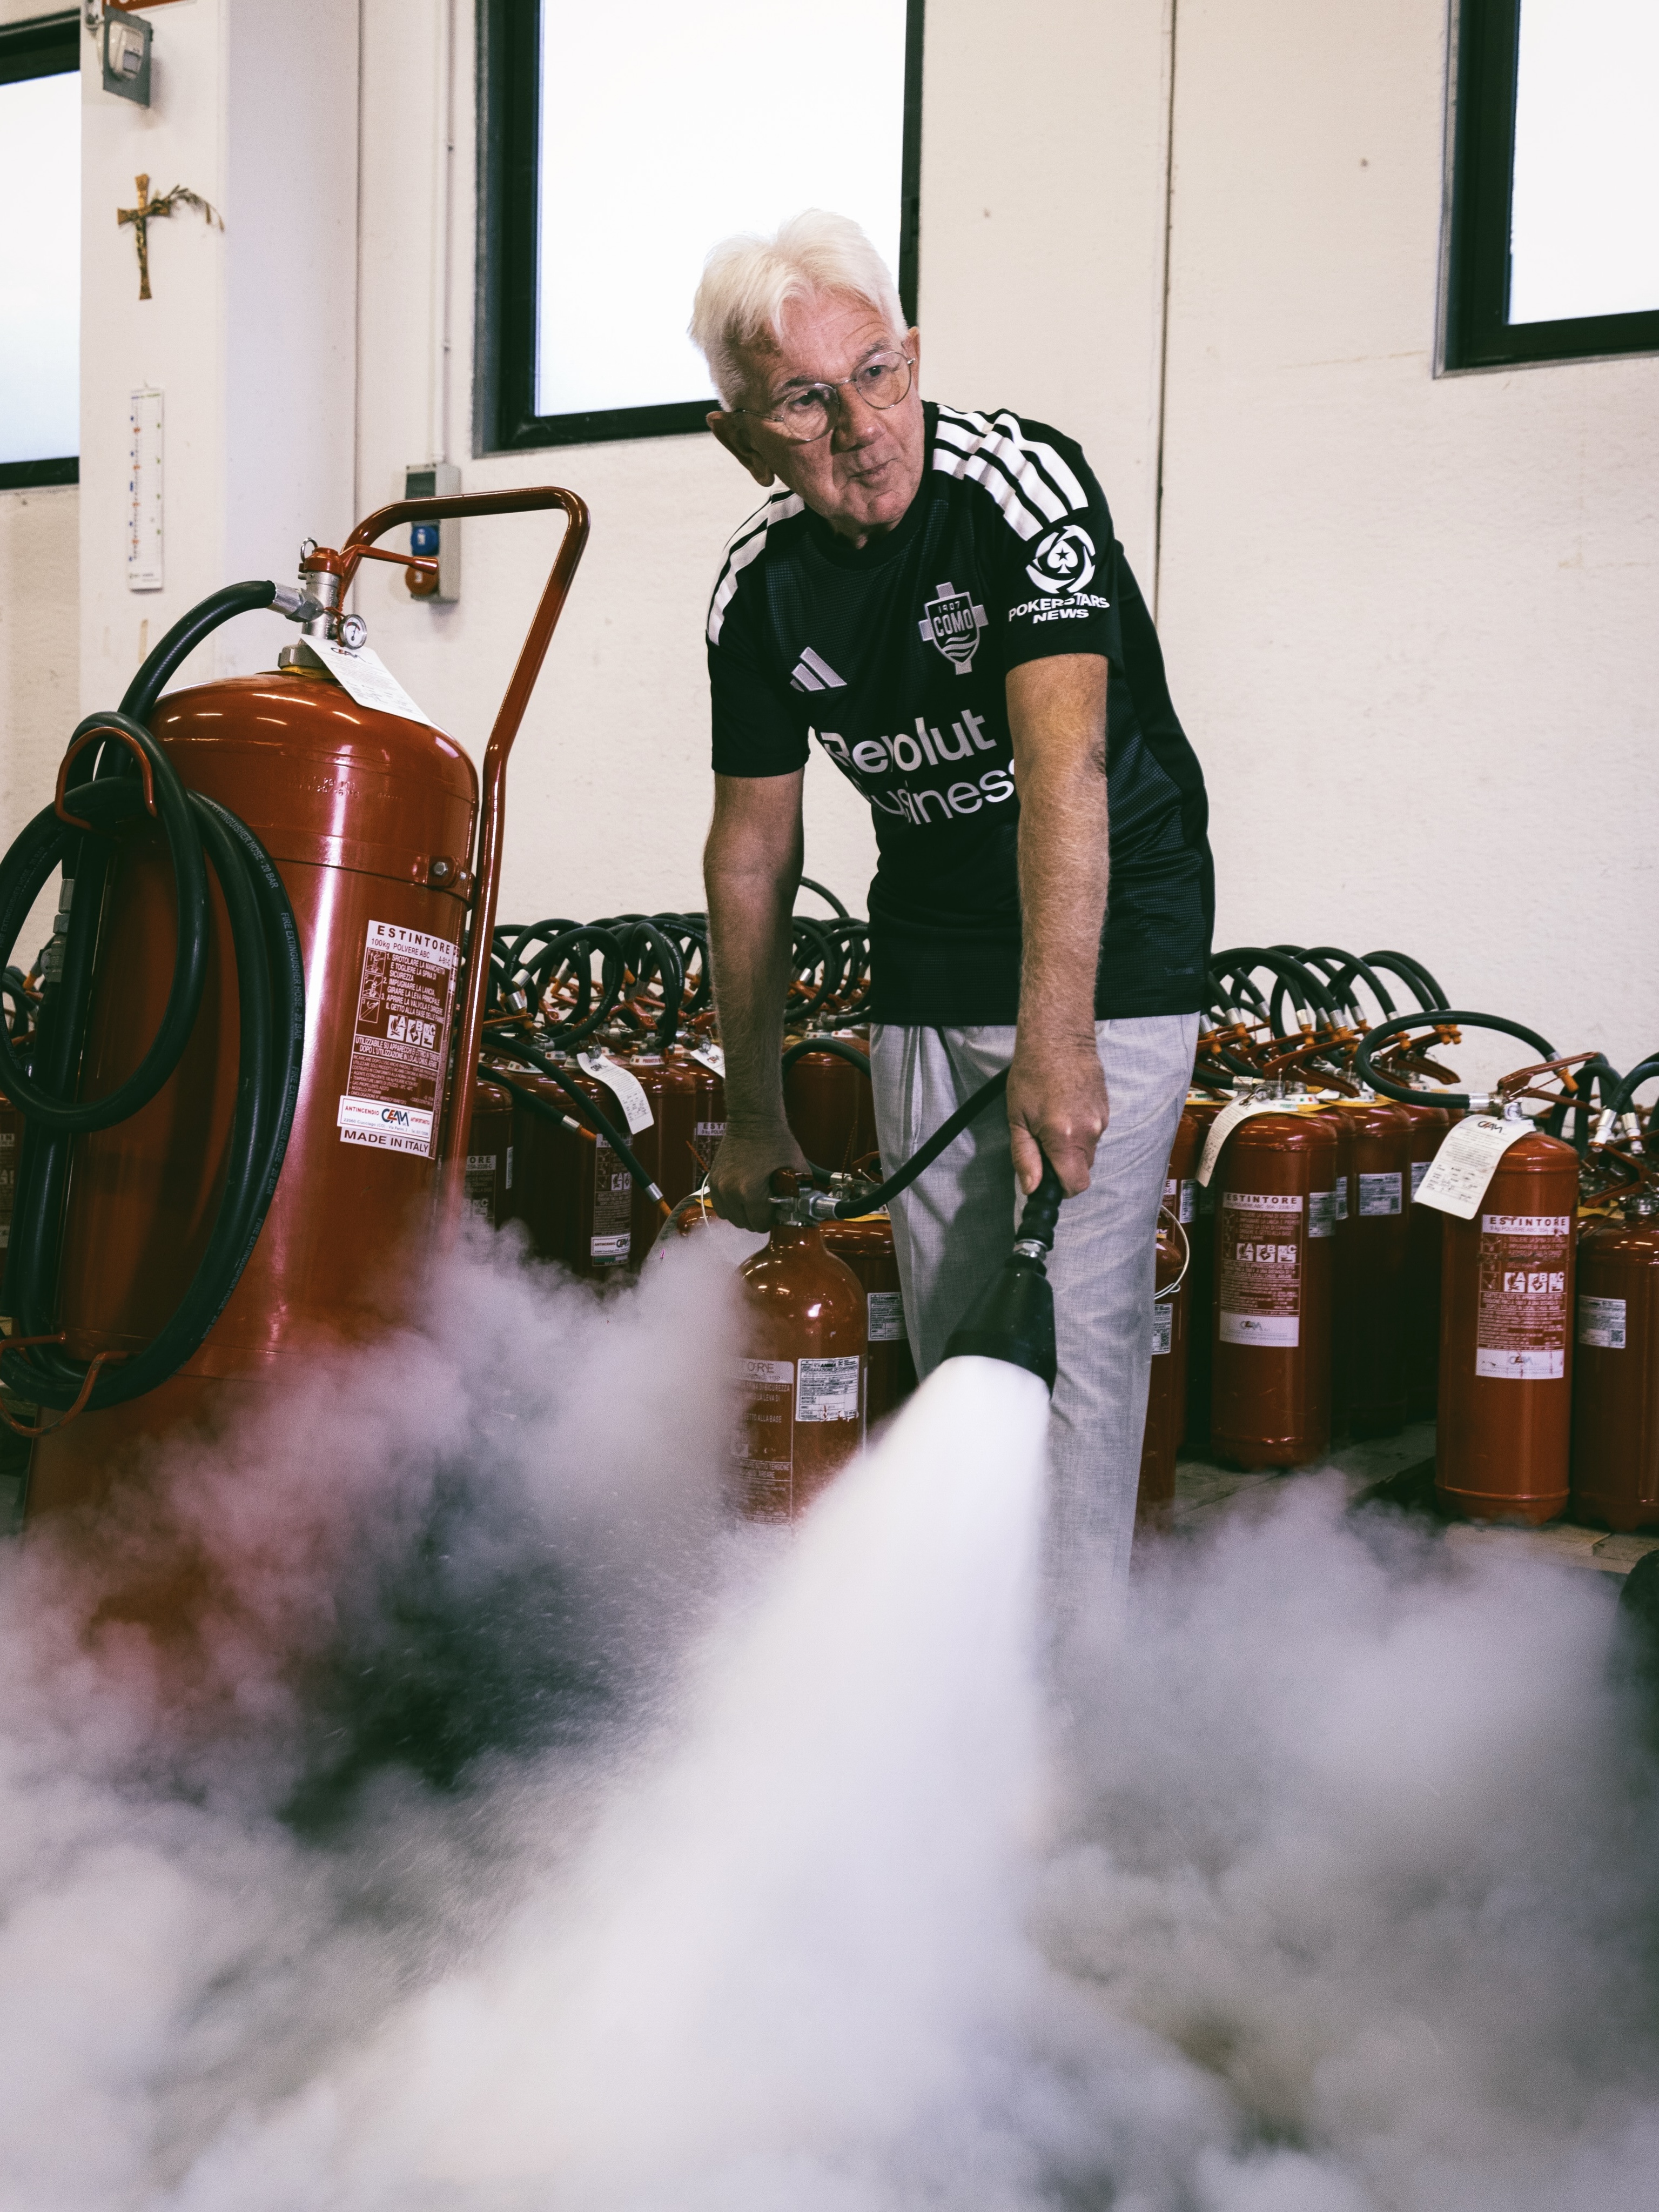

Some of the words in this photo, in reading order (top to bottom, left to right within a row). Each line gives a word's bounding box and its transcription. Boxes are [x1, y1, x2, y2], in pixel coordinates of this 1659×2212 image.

[938, 601, 960, 613] 1907
[1009, 592, 1110, 622] POKERSTARS
[933, 609, 974, 637] COMO
[1032, 608, 1090, 624] NEWS
[247, 839, 264, 861] HOSE
[261, 864, 271, 872] 20
[266, 873, 279, 888] BAR
[281, 912, 292, 929] FIRE
[378, 925, 450, 955] ESTINTORE
[372, 939, 389, 950] 100kg
[393, 943, 418, 955] POLVERE
[420, 950, 430, 958] ABC
[286, 930, 301, 985] EXTINGUISHER
[392, 954, 419, 967] SROTOLARE
[389, 969, 413, 981] SICUREZZA
[395, 963, 415, 974] TOGLIERE
[387, 986, 404, 995] GIRARE
[389, 978, 415, 990] IMPUGNARE
[294, 986, 303, 1008] HOSE
[386, 994, 403, 1004] APRIRE
[411, 1000, 427, 1009] VALVOLA
[295, 1013, 303, 1021] 20
[391, 1003, 405, 1012] GETTO
[415, 1009, 425, 1017] BASE
[398, 1016, 406, 1027] A
[415, 1020, 422, 1031] B
[429, 1024, 435, 1035] C
[355, 1035, 382, 1049] UTILIZZABILE
[389, 1043, 412, 1054] APPARECCHI
[359, 1044, 372, 1053] DOPO
[407, 1055, 419, 1063] LOCALI
[290, 1066, 299, 1083] FIRE
[279, 1085, 297, 1140] EXTINGUISHER
[345, 1106, 379, 1116] ANTINCENDIO
[381, 1109, 409, 1126] CEAM
[345, 1130, 386, 1144] MADE
[391, 1138, 402, 1147] IN
[405, 1141, 428, 1152] ITALY
[275, 1141, 286, 1163] HOSE
[272, 1168, 278, 1177] 20
[266, 1178, 276, 1194] BAR
[1227, 1194, 1297, 1204] ESTINTORE
[1489, 1216, 1566, 1226] ESTINTORE
[1246, 1243, 1254, 1252] A
[1267, 1244, 1276, 1252] B
[1287, 1244, 1297, 1254] C
[1516, 1271, 1526, 1282] A
[1539, 1272, 1548, 1282] B
[1558, 1271, 1565, 1282] C
[770, 1415, 782, 1423] BASE
